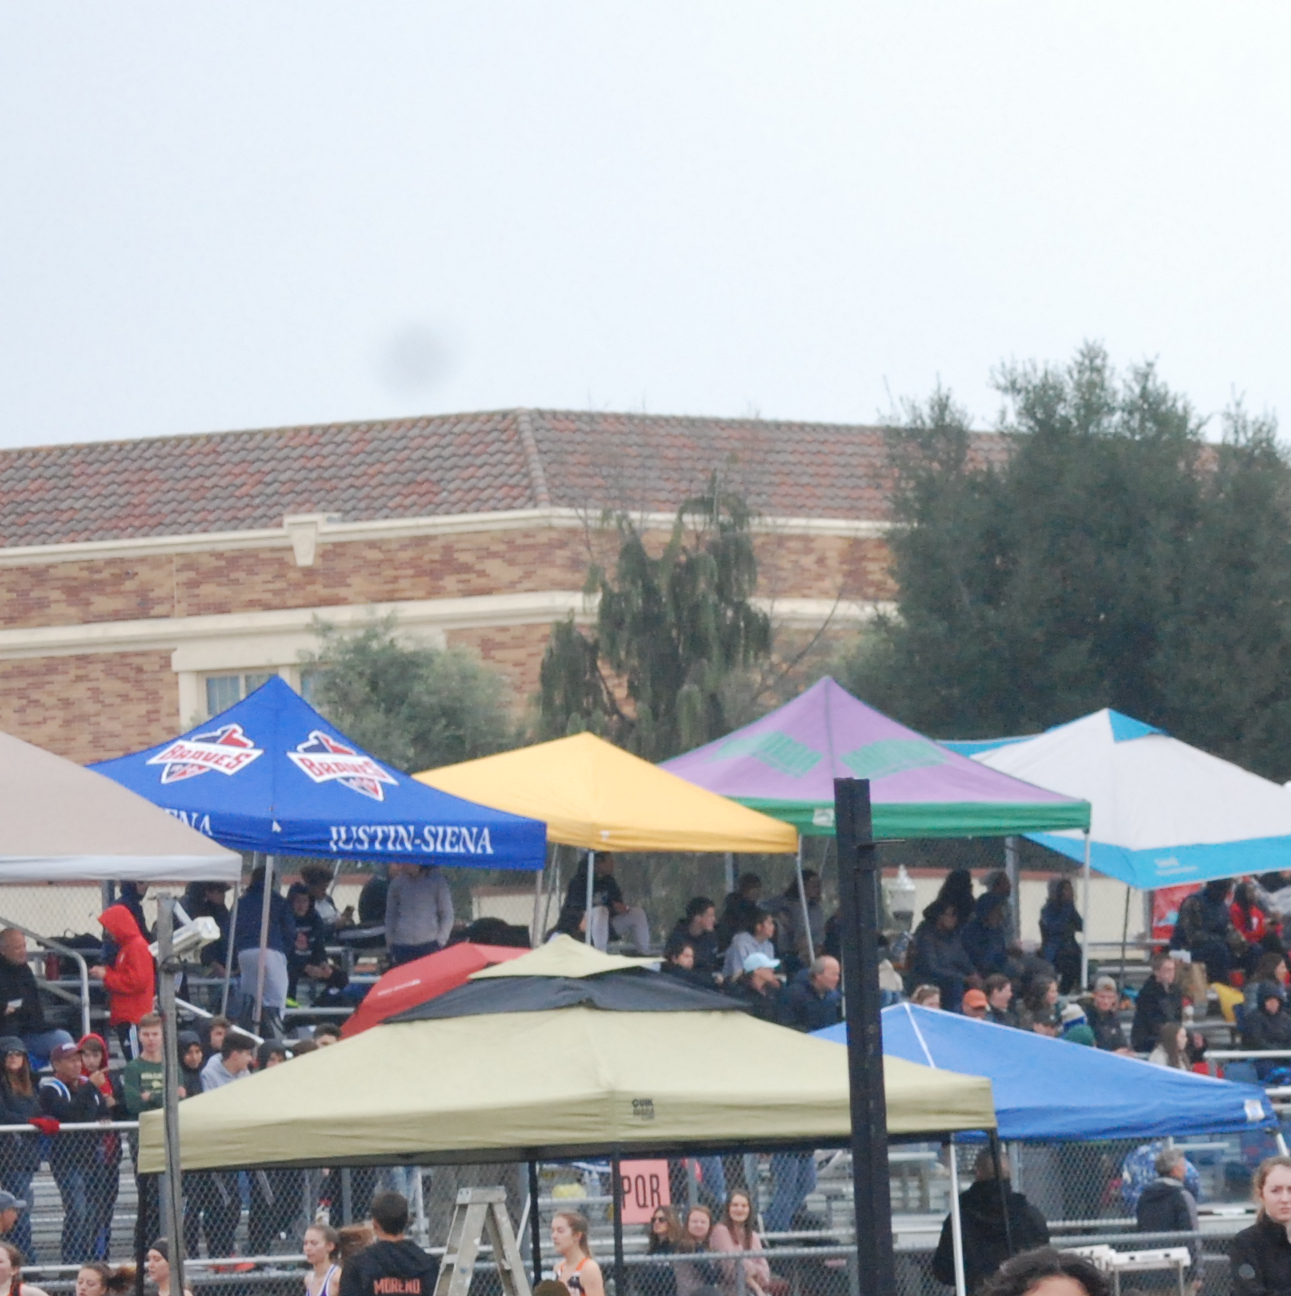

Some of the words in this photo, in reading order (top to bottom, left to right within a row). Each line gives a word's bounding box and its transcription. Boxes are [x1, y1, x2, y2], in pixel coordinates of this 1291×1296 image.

[158, 744, 253, 770] BRAVES
[300, 756, 395, 780] BRAVES
[329, 824, 495, 854] JUSTIN-SIENA
[620, 1173, 662, 1211] PQR
[373, 1277, 421, 1296] MORENO
